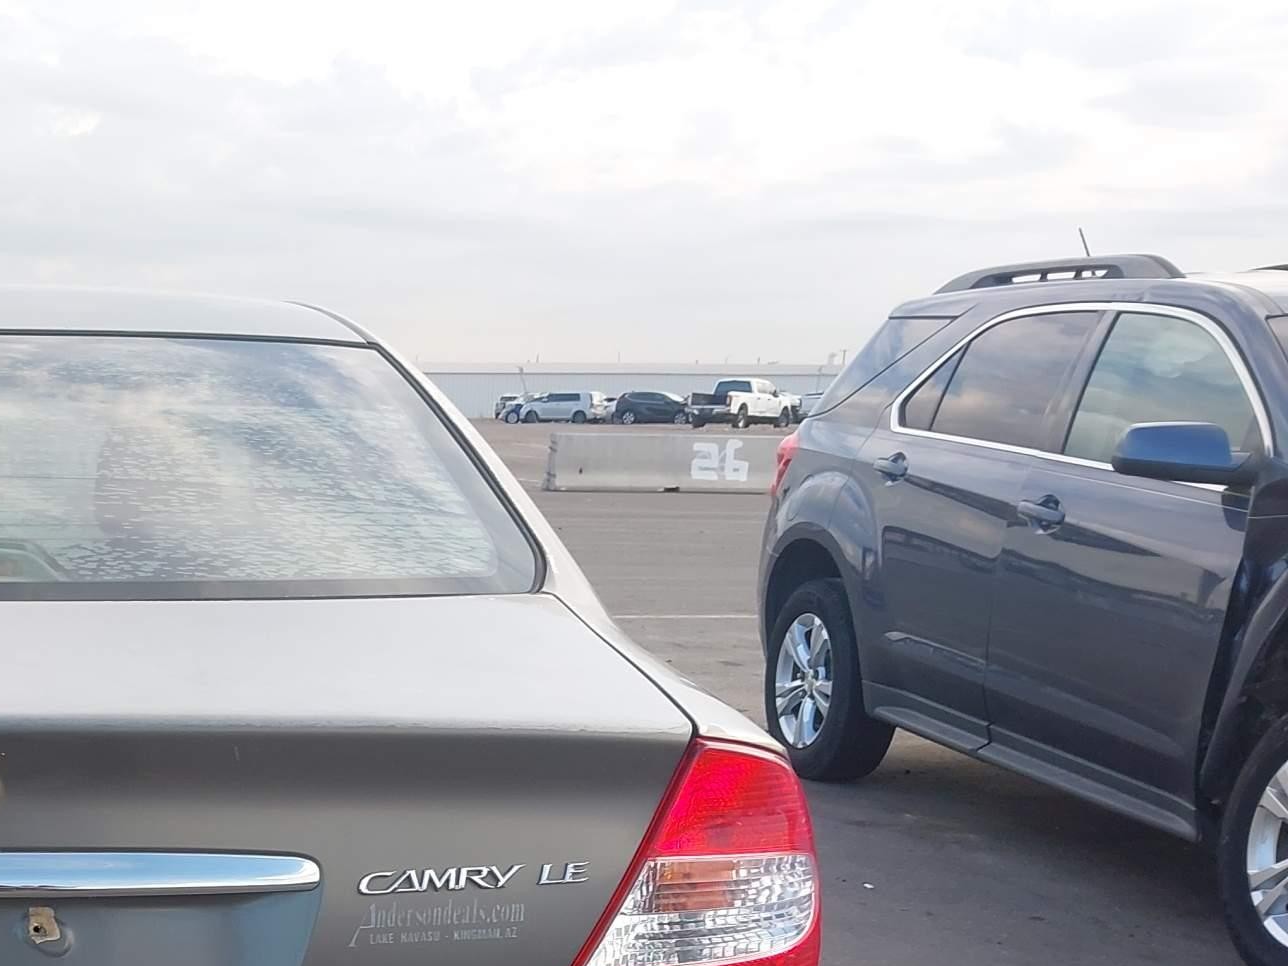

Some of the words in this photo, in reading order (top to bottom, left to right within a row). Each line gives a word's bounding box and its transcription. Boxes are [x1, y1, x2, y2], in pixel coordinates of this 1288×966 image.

[691, 438, 749, 482] 26
[358, 864, 526, 895] CAMRY
[537, 861, 590, 885] LE
[369, 932, 394, 945] LAKE
[400, 930, 441, 944] HAVASU
[504, 926, 518, 938] AZ
